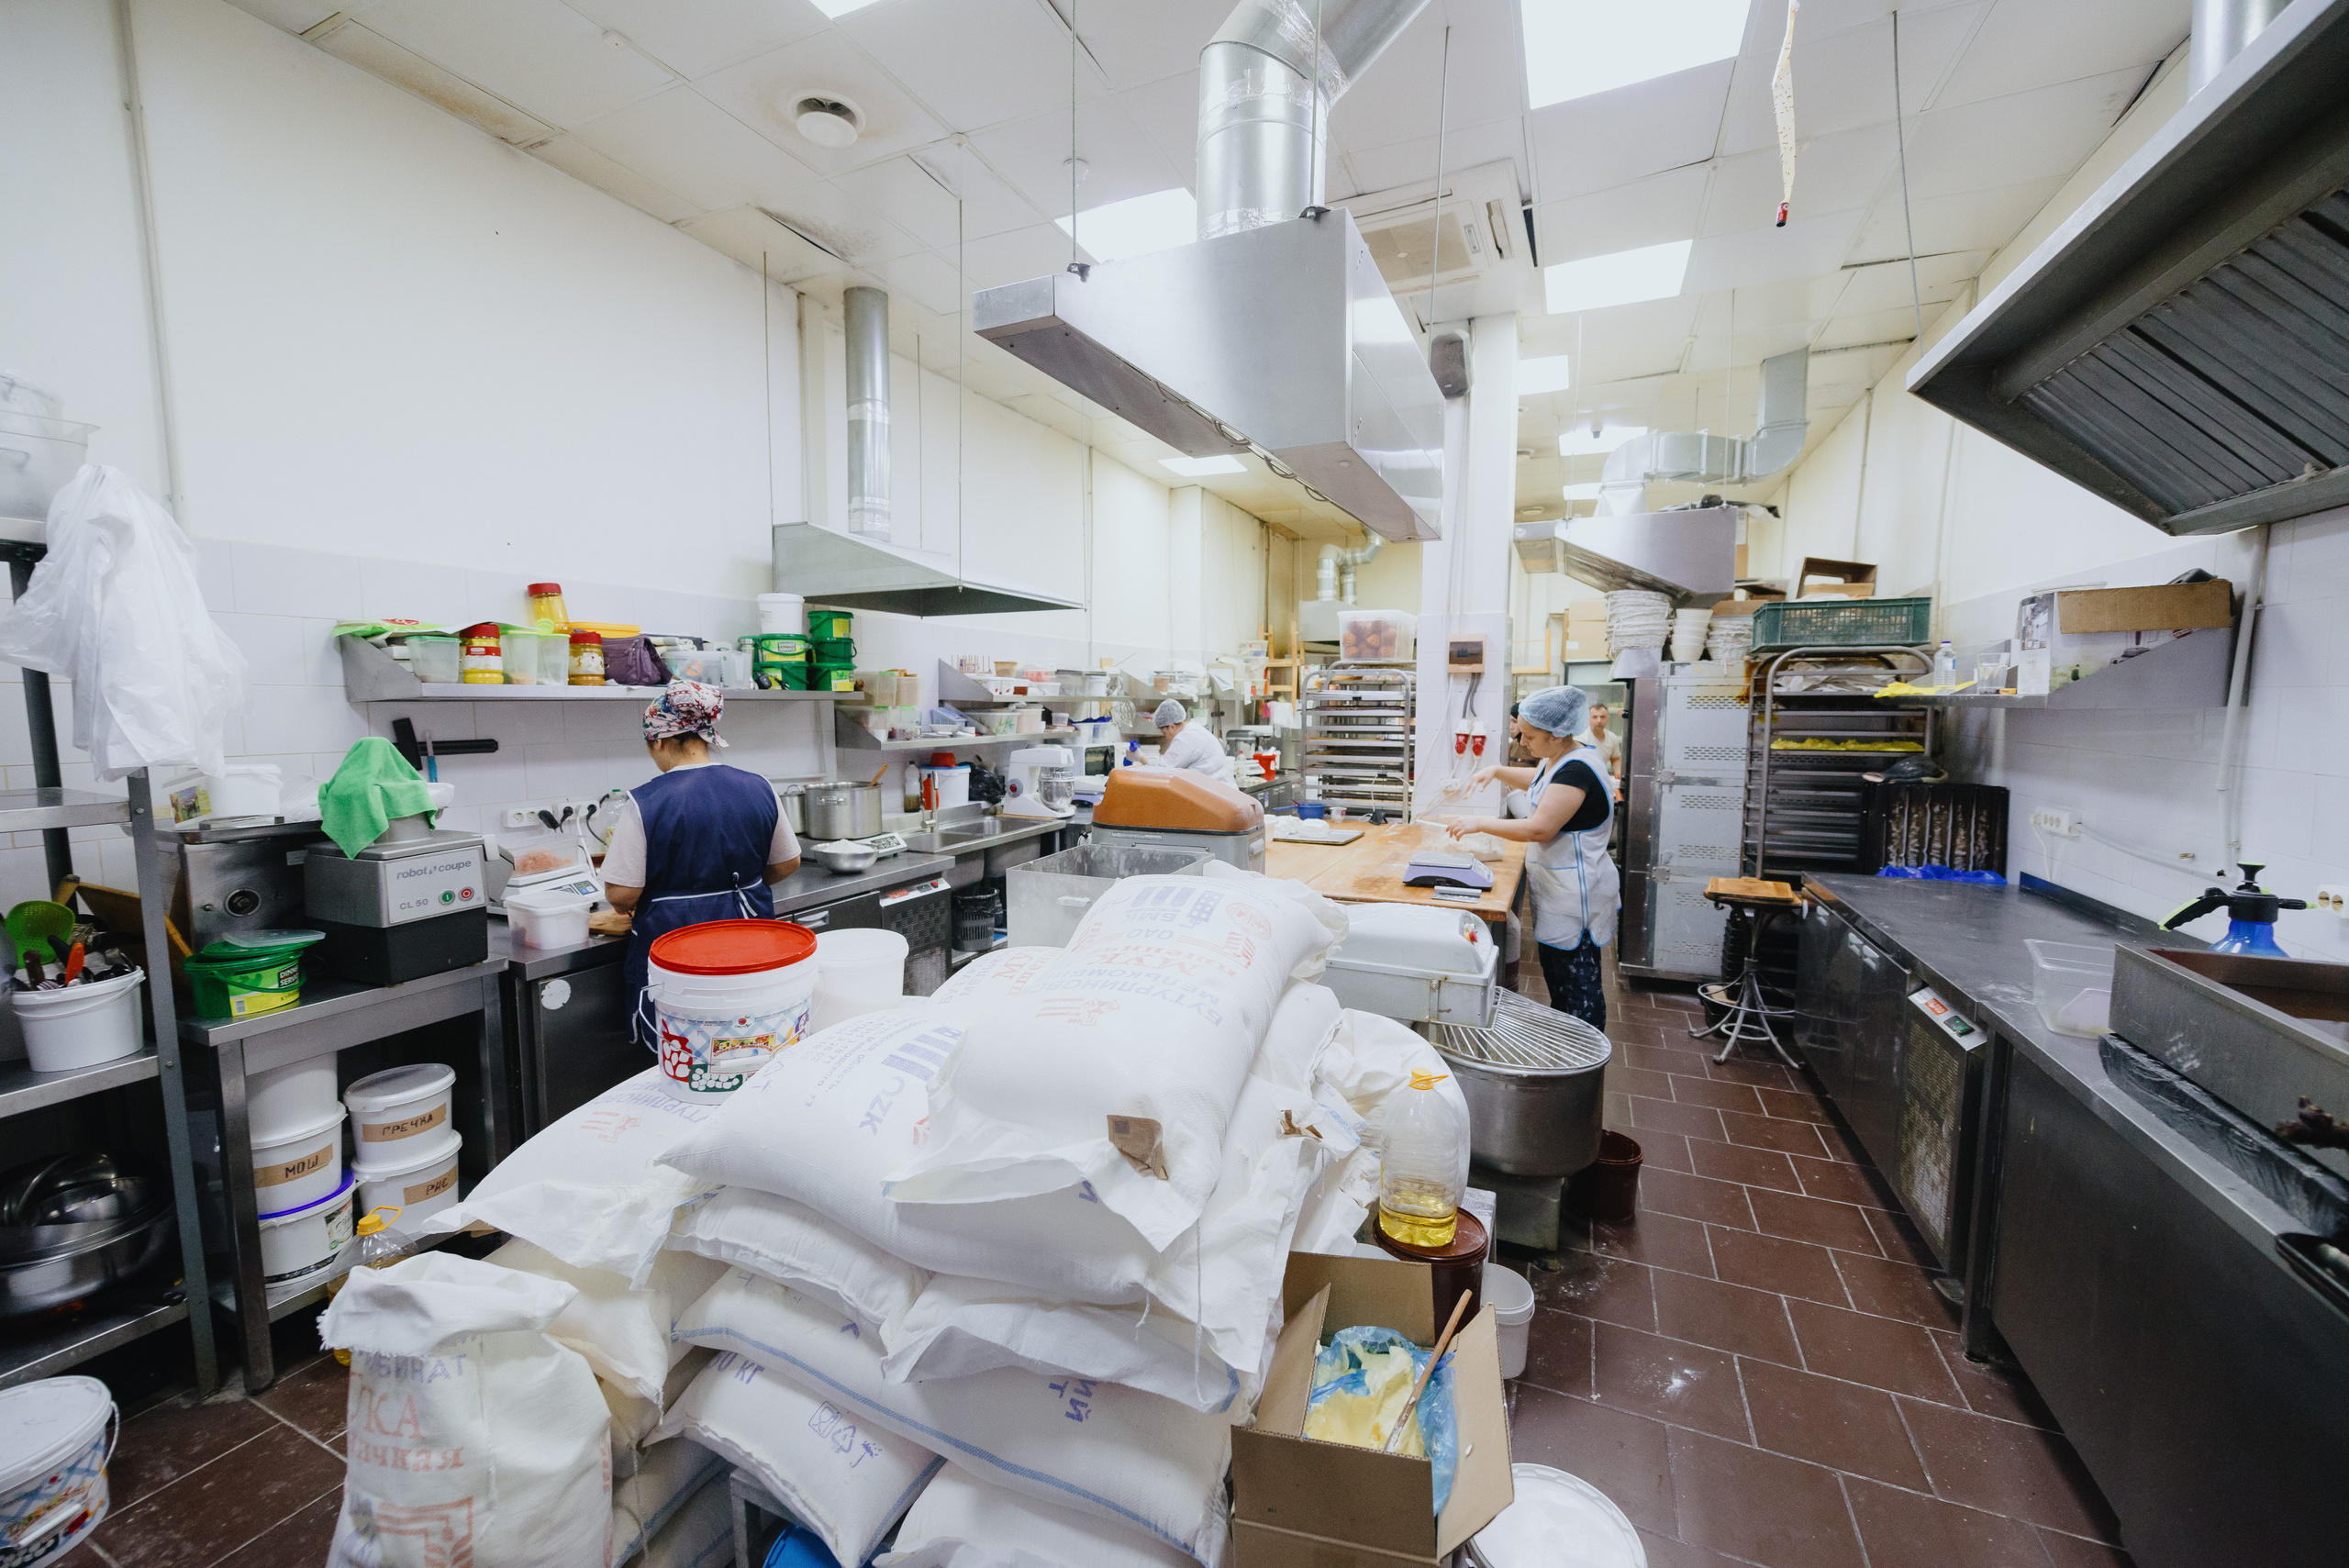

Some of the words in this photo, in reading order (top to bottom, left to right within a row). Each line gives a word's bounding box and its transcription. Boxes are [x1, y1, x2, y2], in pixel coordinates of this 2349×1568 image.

[396, 866, 428, 881] robot
[438, 860, 472, 873] coupe
[399, 902, 413, 910] CL
[416, 898, 429, 908] 50
[382, 1113, 433, 1136] ГРЕЧКА
